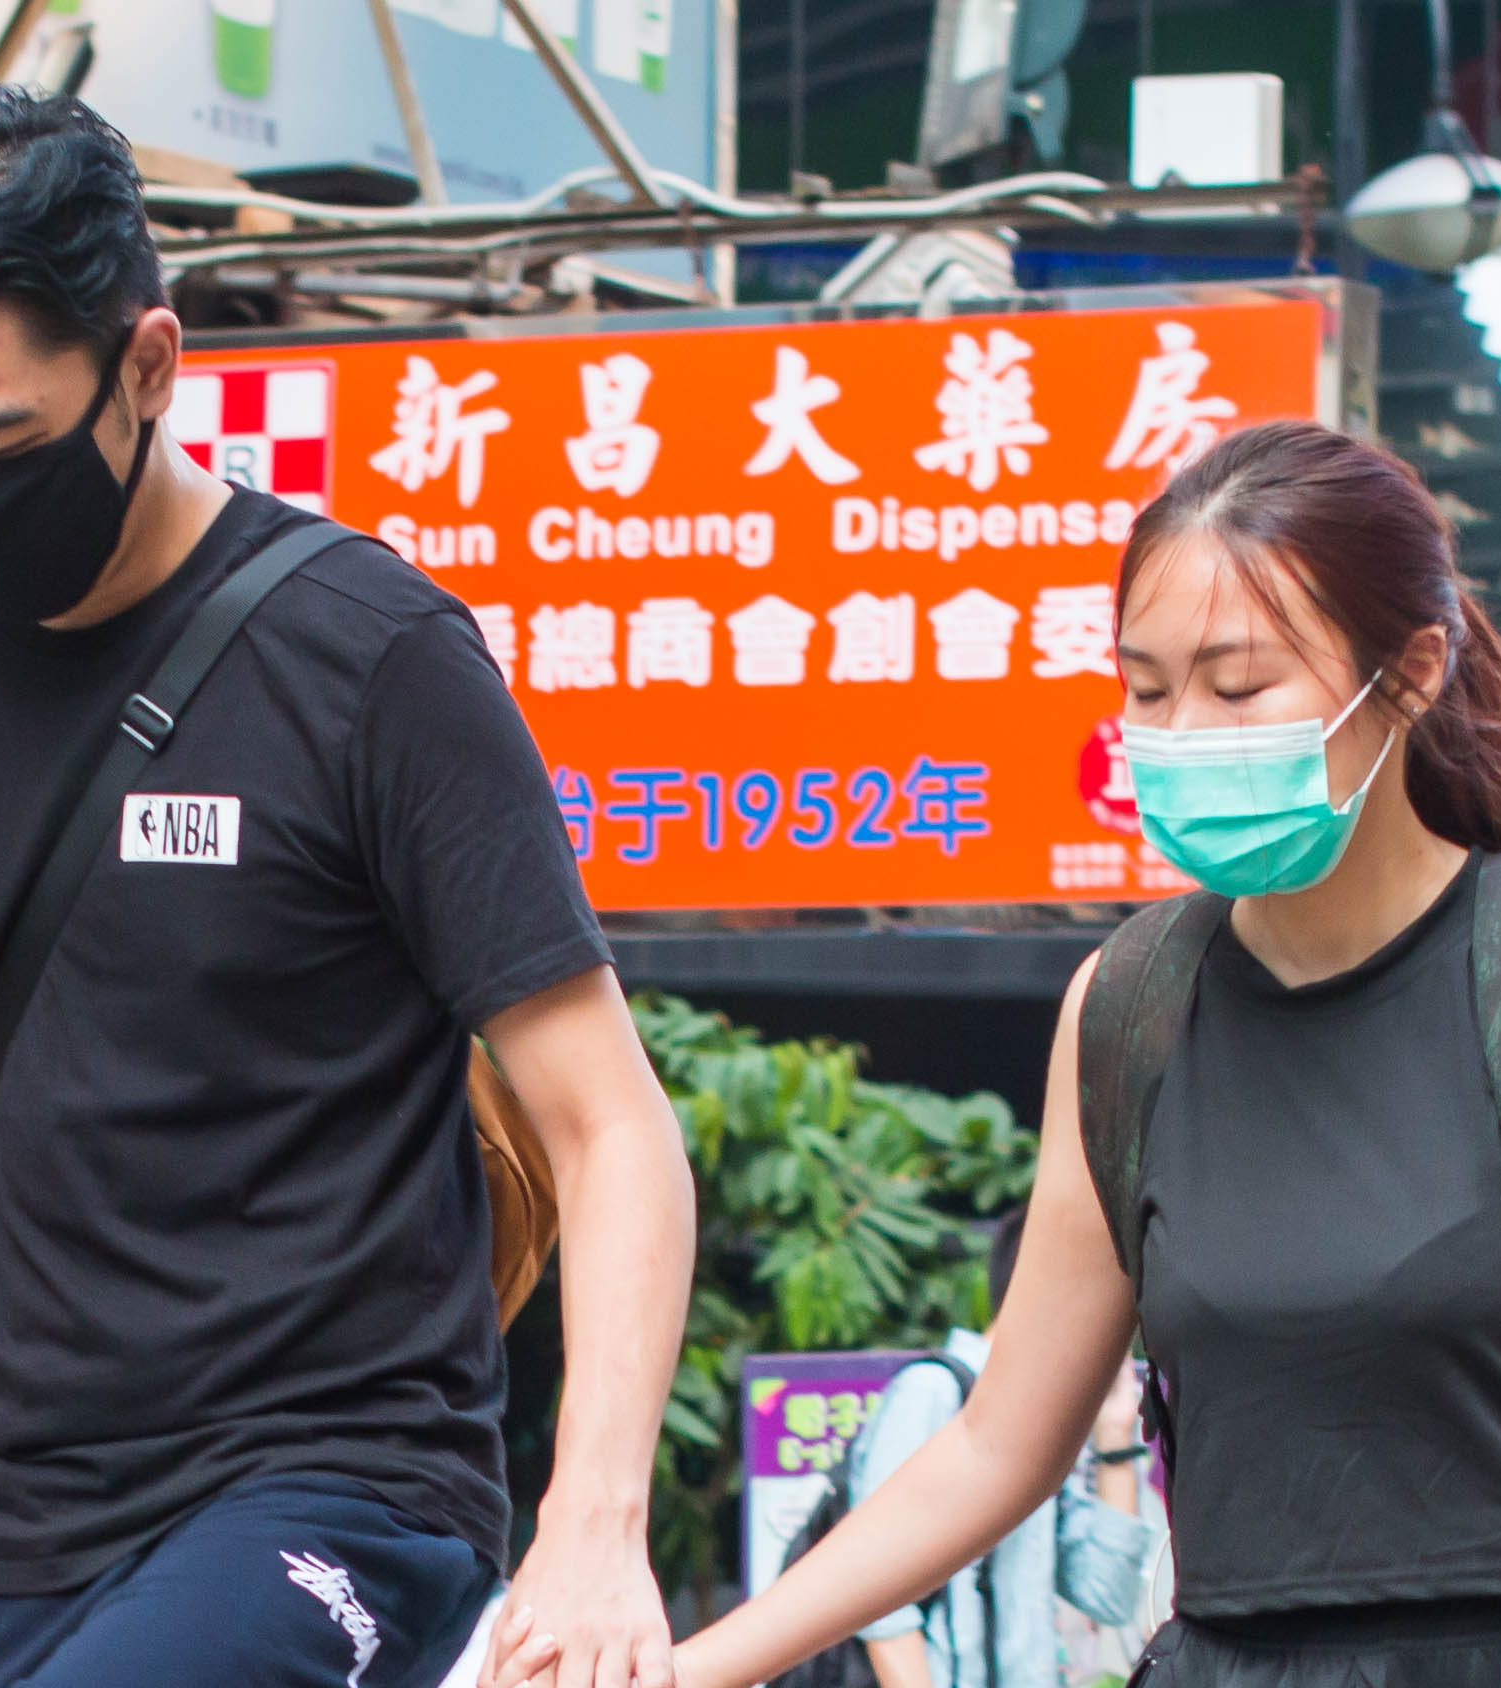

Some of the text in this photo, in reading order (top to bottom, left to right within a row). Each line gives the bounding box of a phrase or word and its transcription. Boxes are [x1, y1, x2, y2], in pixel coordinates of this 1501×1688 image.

[367, 321, 1239, 509] 新昌大藥房
[376, 513, 498, 569] Sun
[527, 505, 776, 569] Cheung
[162, 802, 219, 857] NBA
